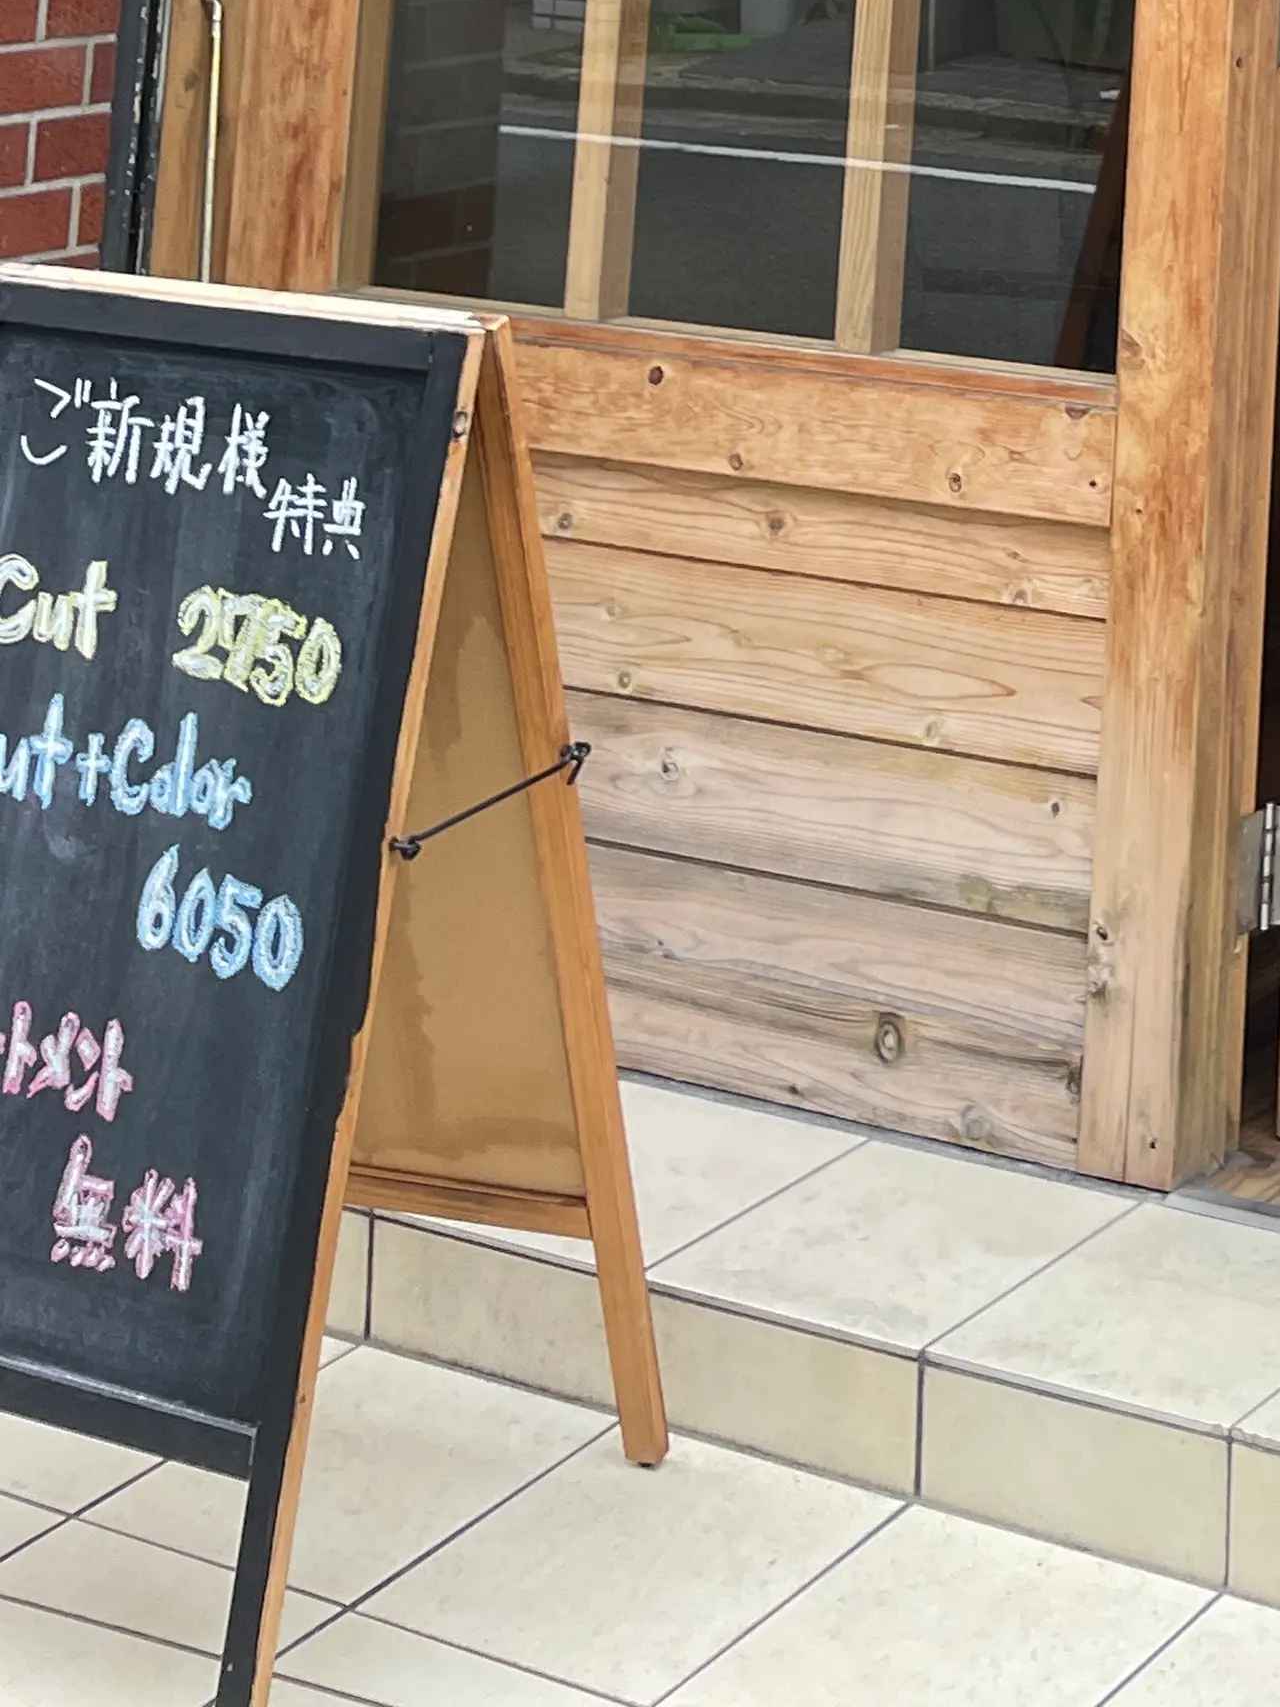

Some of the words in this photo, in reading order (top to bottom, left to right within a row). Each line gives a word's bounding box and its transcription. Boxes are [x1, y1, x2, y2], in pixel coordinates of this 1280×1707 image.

[20, 376, 272, 500] ご新規様
[262, 472, 366, 561] 特典
[0, 552, 118, 661] Cut
[171, 583, 344, 708] 2750
[136, 843, 305, 993] 6050
[0, 999, 134, 1123] トメント
[49, 1133, 204, 1293] 無料
